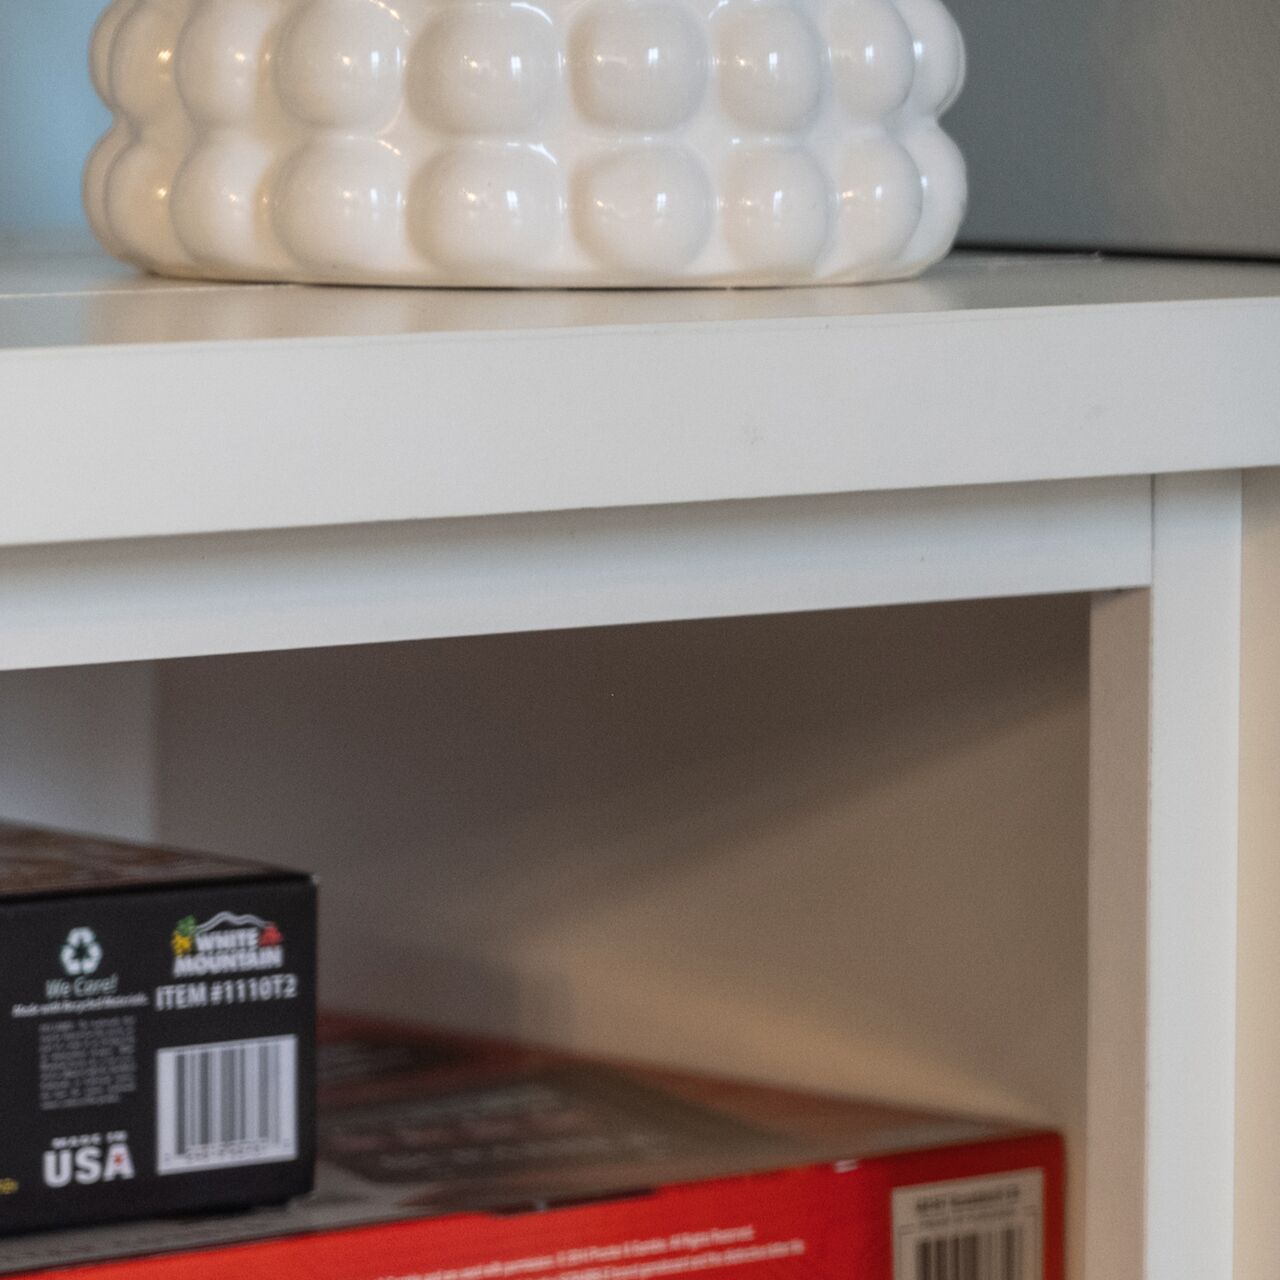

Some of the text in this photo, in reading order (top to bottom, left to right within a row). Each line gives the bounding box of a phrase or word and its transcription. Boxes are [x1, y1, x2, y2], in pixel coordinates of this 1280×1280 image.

[195, 928, 257, 952] WHITE
[174, 947, 281, 975] MOUNTAIN
[45, 974, 117, 998] We Care!
[155, 982, 207, 1009] ITEM
[51, 1130, 127, 1149] MADE IN
[43, 1143, 133, 1186] USA
